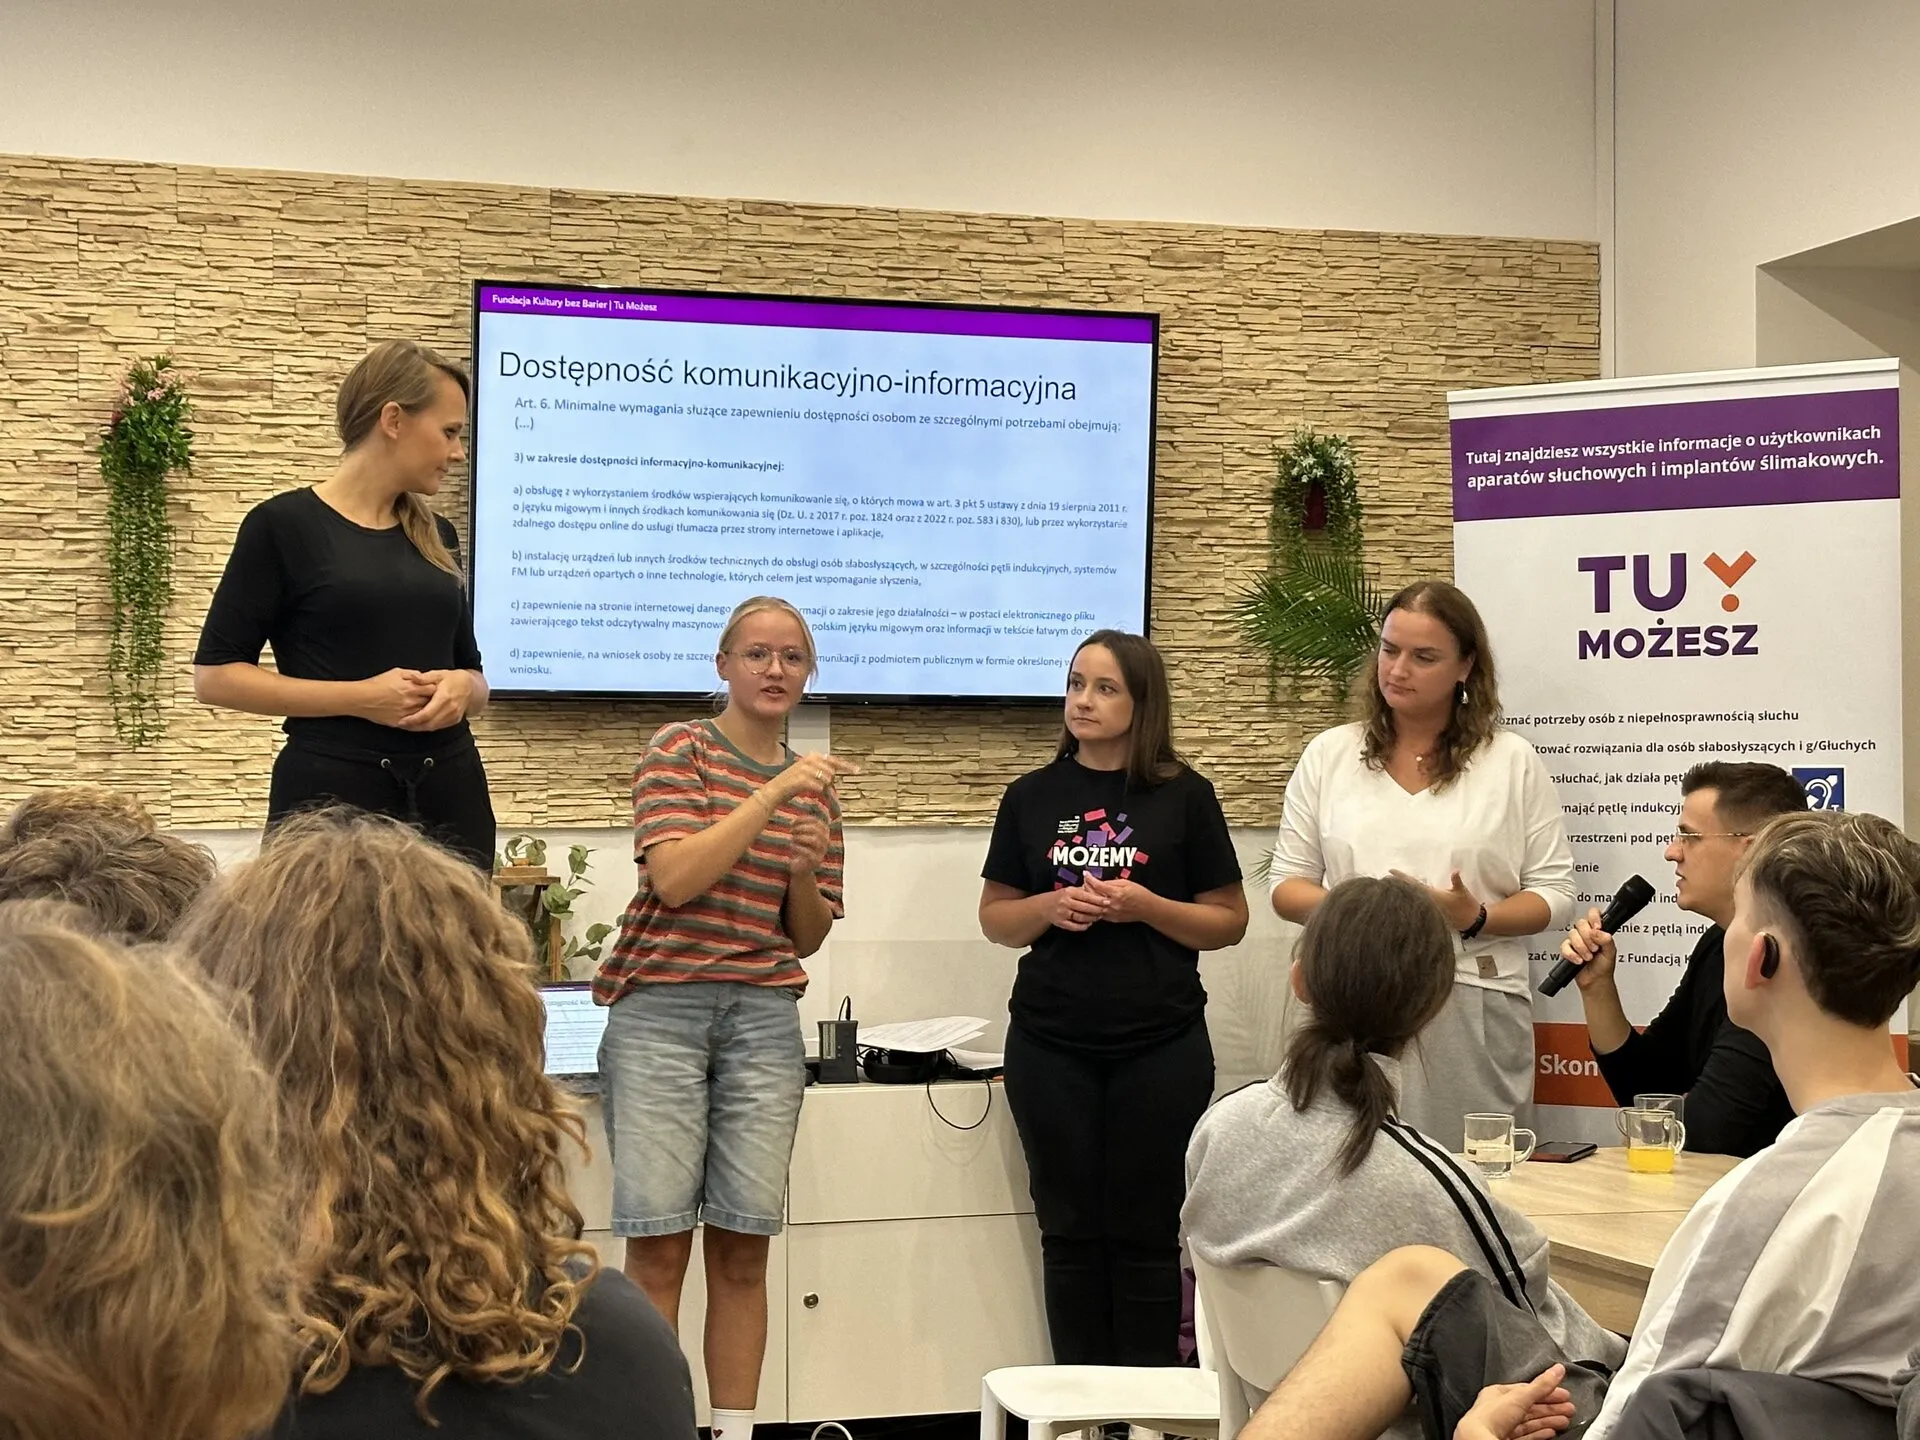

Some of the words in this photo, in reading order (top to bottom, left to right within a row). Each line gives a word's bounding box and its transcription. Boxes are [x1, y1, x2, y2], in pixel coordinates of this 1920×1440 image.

[492, 294, 530, 306] Fundacja
[532, 296, 563, 308] Kultury
[564, 297, 580, 307] bez
[582, 298, 607, 308] Barier
[613, 300, 624, 309] Tu
[625, 301, 657, 311] Możesz
[500, 351, 672, 386] Dostępność
[684, 359, 1075, 405] komunikacyjno-informacyjna
[540, 398, 550, 409] 6.
[554, 399, 616, 411] Minimalne
[619, 403, 683, 416] wymagania
[686, 404, 727, 418] służące
[730, 408, 800, 419] zapewnieniu
[803, 408, 868, 422] dostępności
[872, 412, 916, 423] osobom
[919, 415, 930, 423] ze
[933, 414, 1002, 428] szczególnymi
[1005, 417, 1065, 429] potrzebami
[1465, 449, 1500, 465] Tutaj
[1504, 446, 1578, 463] znajdziesz
[1581, 440, 1654, 458] wszystkie
[1658, 434, 1741, 451] informacje
[1745, 436, 1755, 446] o
[1760, 425, 1880, 448] użytkownikach
[537, 453, 577, 463] zakresie
[579, 454, 637, 466] dostępności
[1467, 469, 1544, 491] aparatów
[1548, 462, 1646, 482] słuchowych
[1651, 461, 1655, 476] i
[1661, 456, 1755, 478] implantów
[1760, 448, 1883, 470] ślimakowych.
[1578, 552, 1687, 614] TU
[1578, 617, 1759, 660] MOŻESZ
[1534, 714, 1585, 727] potrzeby
[1588, 713, 1615, 723] osób
[1618, 715, 1624, 723] z
[1627, 710, 1754, 725] niepełnosprawnością
[1758, 710, 1798, 720] słuchu
[1532, 743, 1570, 753] tować
[1573, 742, 1642, 755] rozwiązania
[1646, 742, 1663, 752] dla
[1667, 741, 1694, 752] osób
[1698, 740, 1795, 754] słabosłyszących
[1799, 740, 1802, 750] i
[1806, 739, 1875, 753] g/Głuchych
[1604, 772, 1622, 785] jak
[1626, 772, 1660, 782] działa
[1664, 774, 1684, 786] pęt
[1561, 802, 1594, 815] nająć
[1598, 802, 1627, 815] pętlę
[1630, 802, 1683, 815] indukcyj
[1566, 832, 1626, 842] rzestrzeni
[1630, 832, 1652, 845] pod
[1052, 844, 1138, 867] MOŻEMY
[1652, 923, 1682, 936] pętlą
[1628, 953, 1681, 967] Fundacją
[1539, 1054, 1599, 1076] Skon
